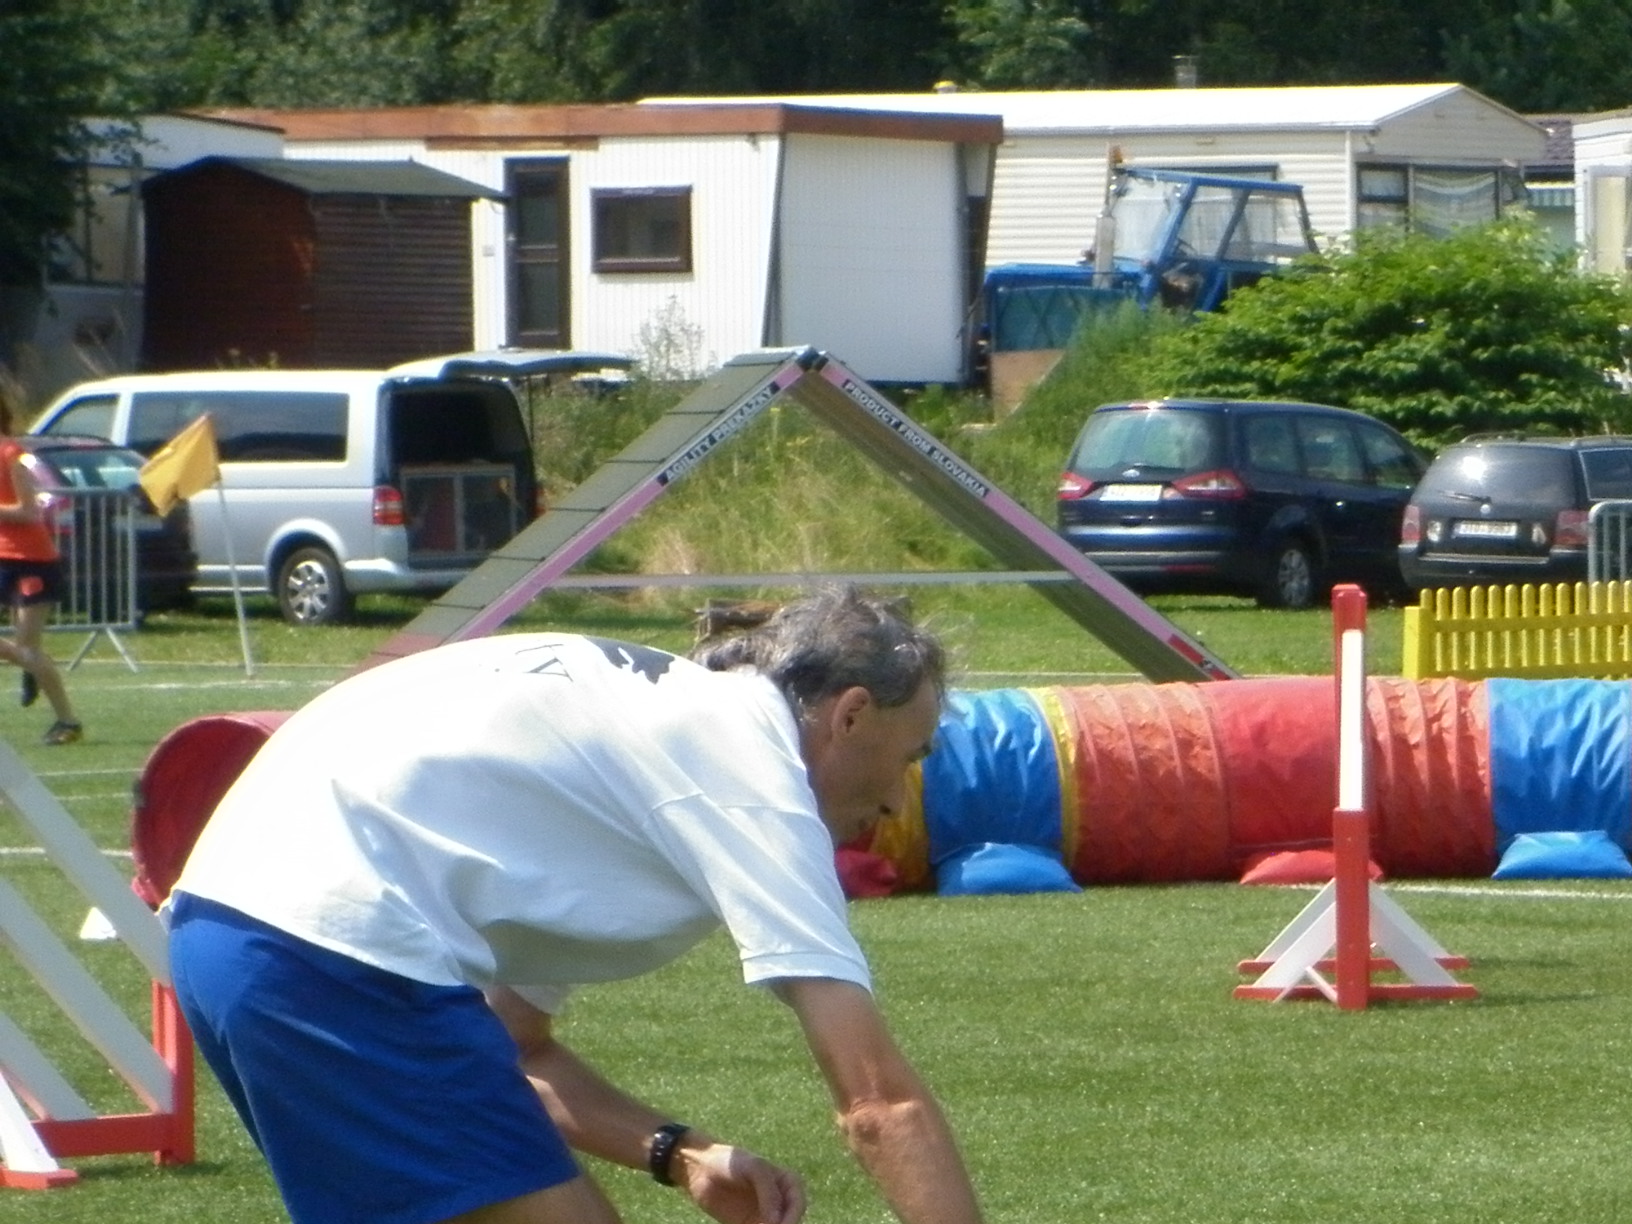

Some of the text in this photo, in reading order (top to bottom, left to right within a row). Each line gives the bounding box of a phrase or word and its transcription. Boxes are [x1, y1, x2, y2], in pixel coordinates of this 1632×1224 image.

[666, 434, 712, 480] AGILITY
[844, 381, 988, 497] PRODUCT FROM SLOVAKIA
